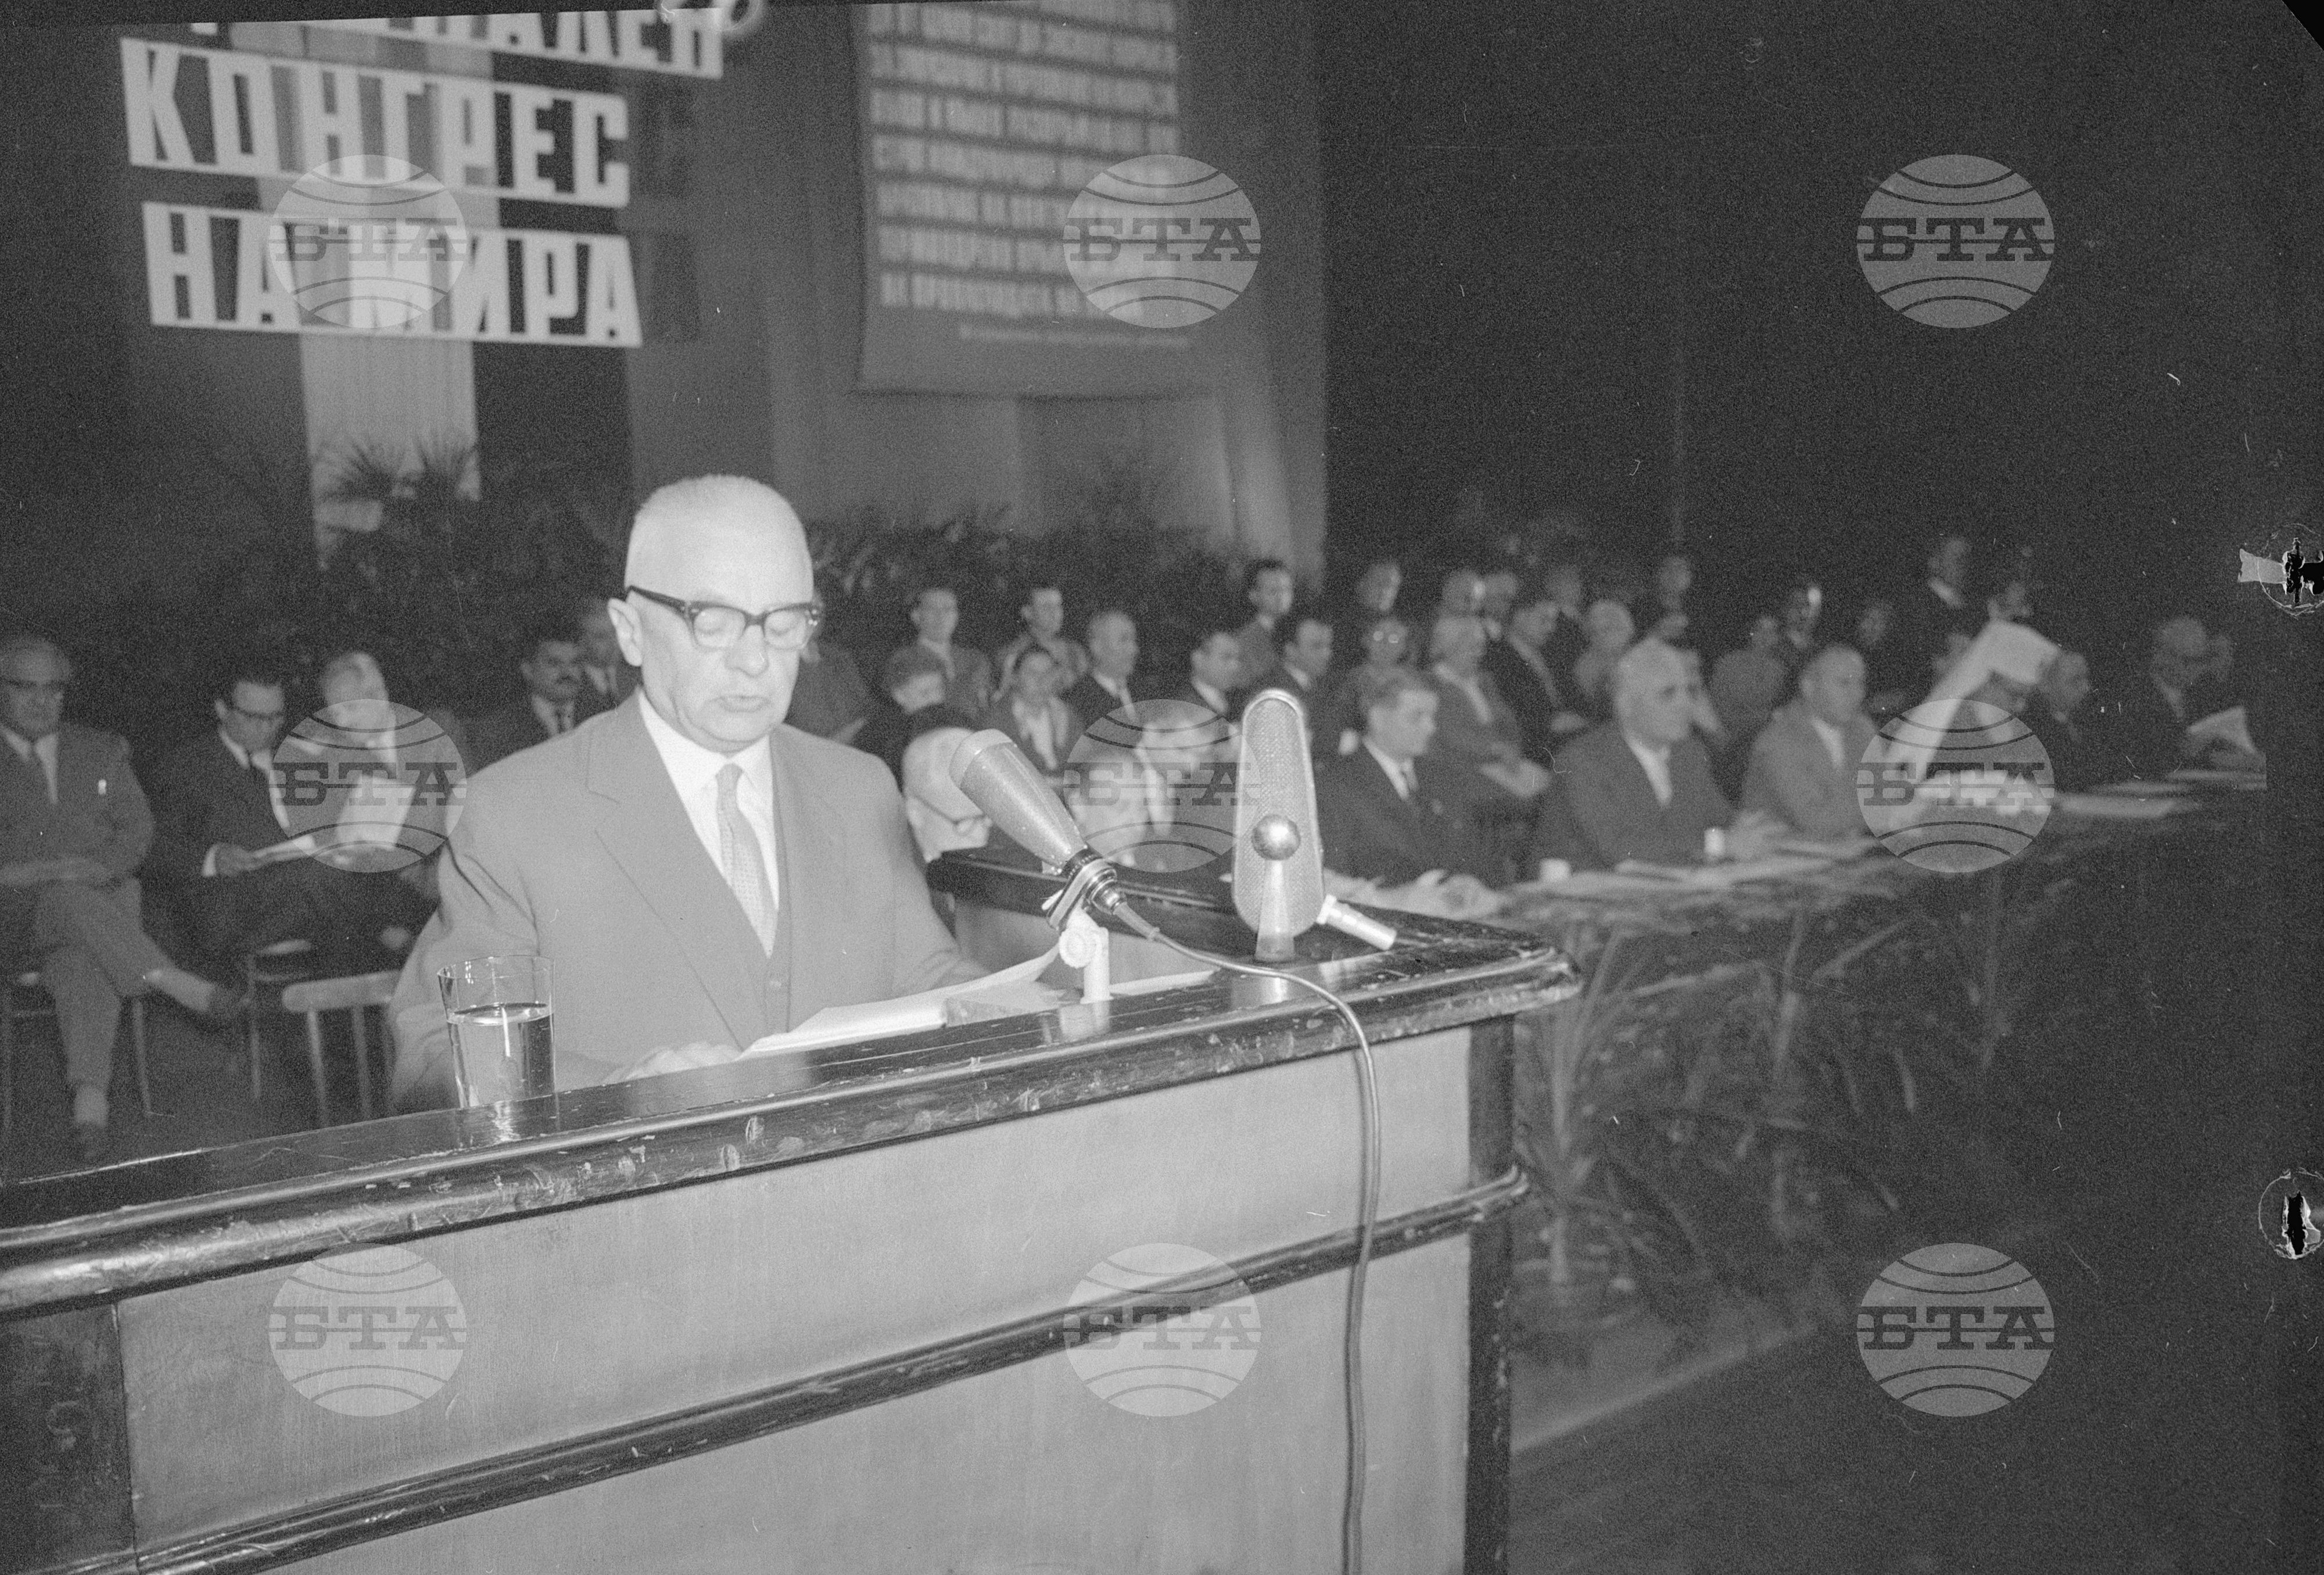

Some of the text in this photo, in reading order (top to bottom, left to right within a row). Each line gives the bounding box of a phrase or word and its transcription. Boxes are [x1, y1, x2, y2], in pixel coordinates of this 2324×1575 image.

[120, 37, 630, 208] КОНГРЕС
[142, 202, 643, 348] НА МИРА
